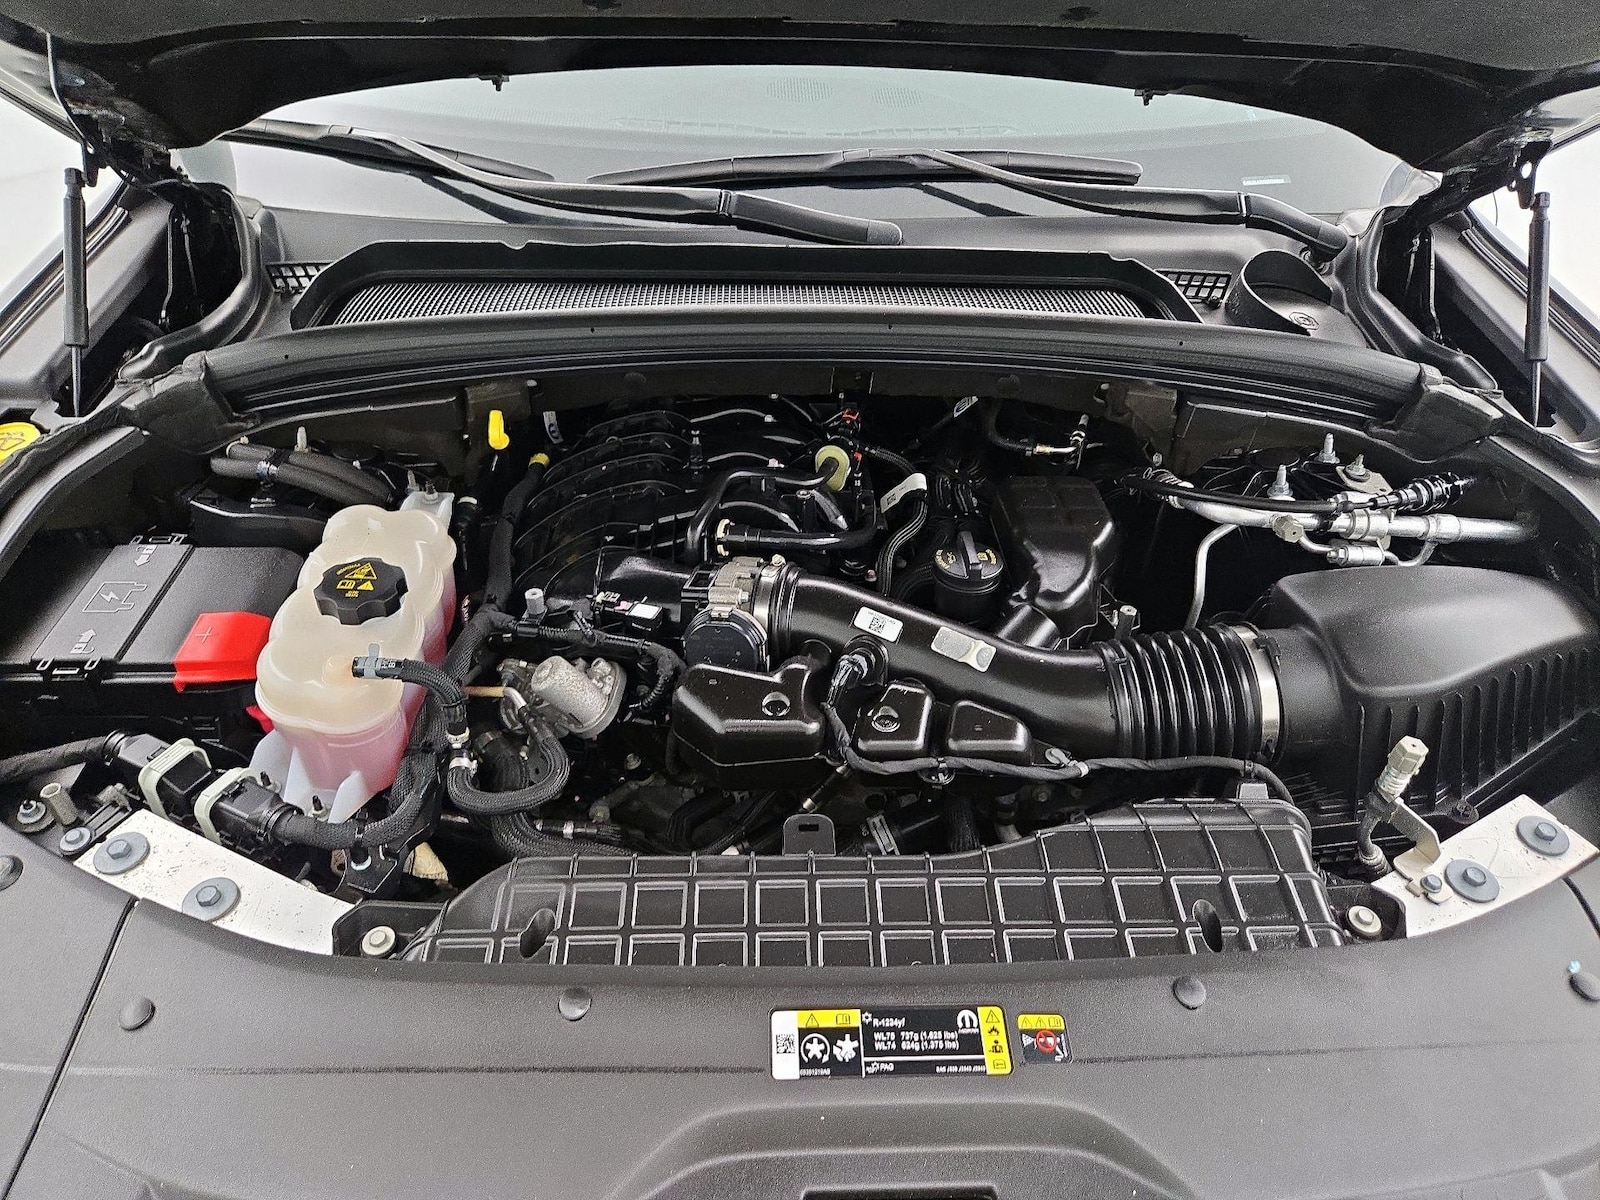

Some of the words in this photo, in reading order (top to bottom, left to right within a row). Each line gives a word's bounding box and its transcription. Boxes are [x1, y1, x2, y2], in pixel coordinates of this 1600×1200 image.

[873, 1017, 905, 1028] R-1234yf
[874, 1031, 895, 1041] WL75
[875, 1041, 896, 1050] WL74
